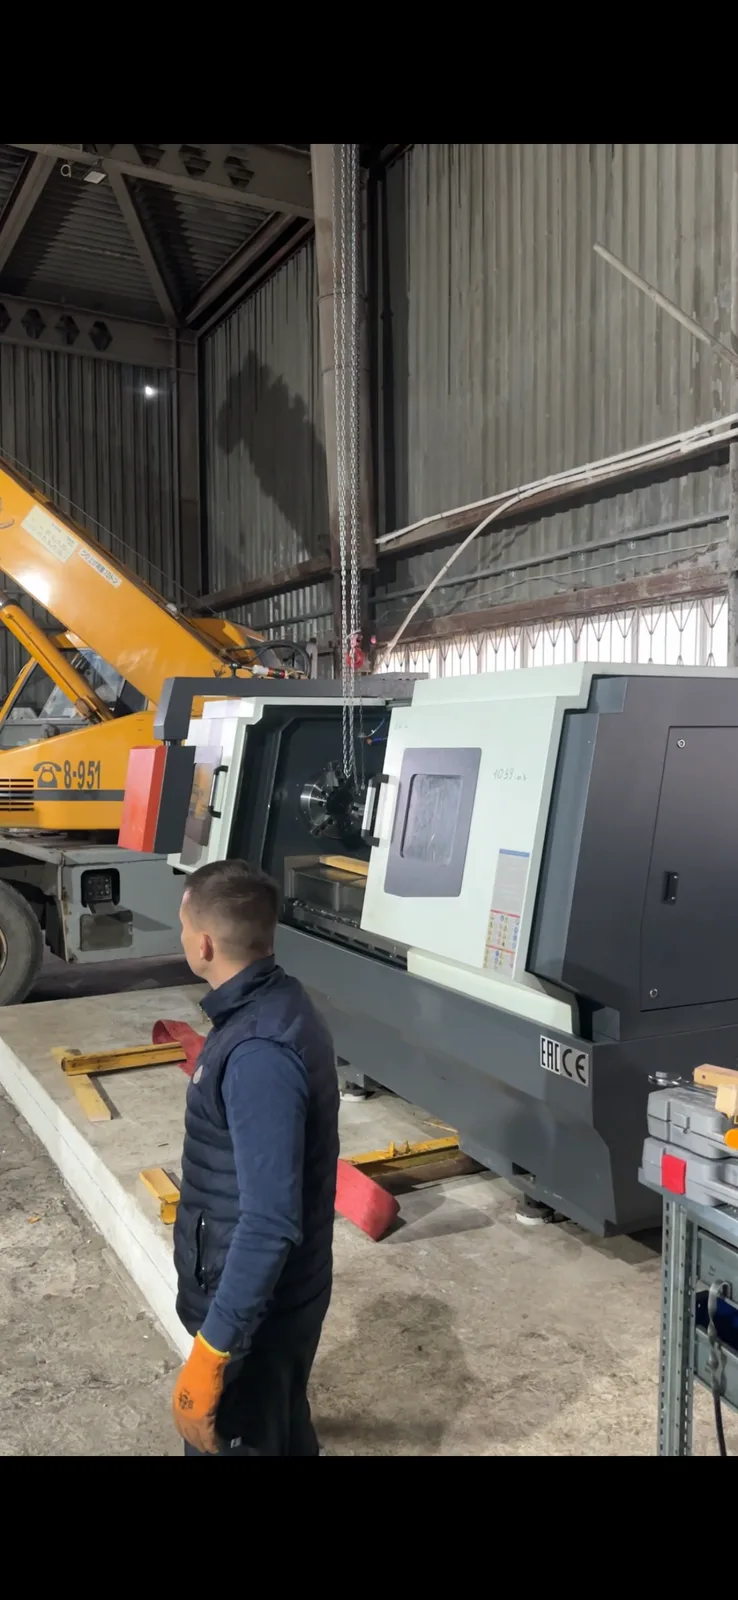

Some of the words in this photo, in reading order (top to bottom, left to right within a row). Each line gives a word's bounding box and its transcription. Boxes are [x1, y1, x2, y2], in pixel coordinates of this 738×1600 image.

[64, 760, 101, 789] 8-951
[541, 1037, 560, 1073] EAC
[562, 1048, 587, 1085] CE
